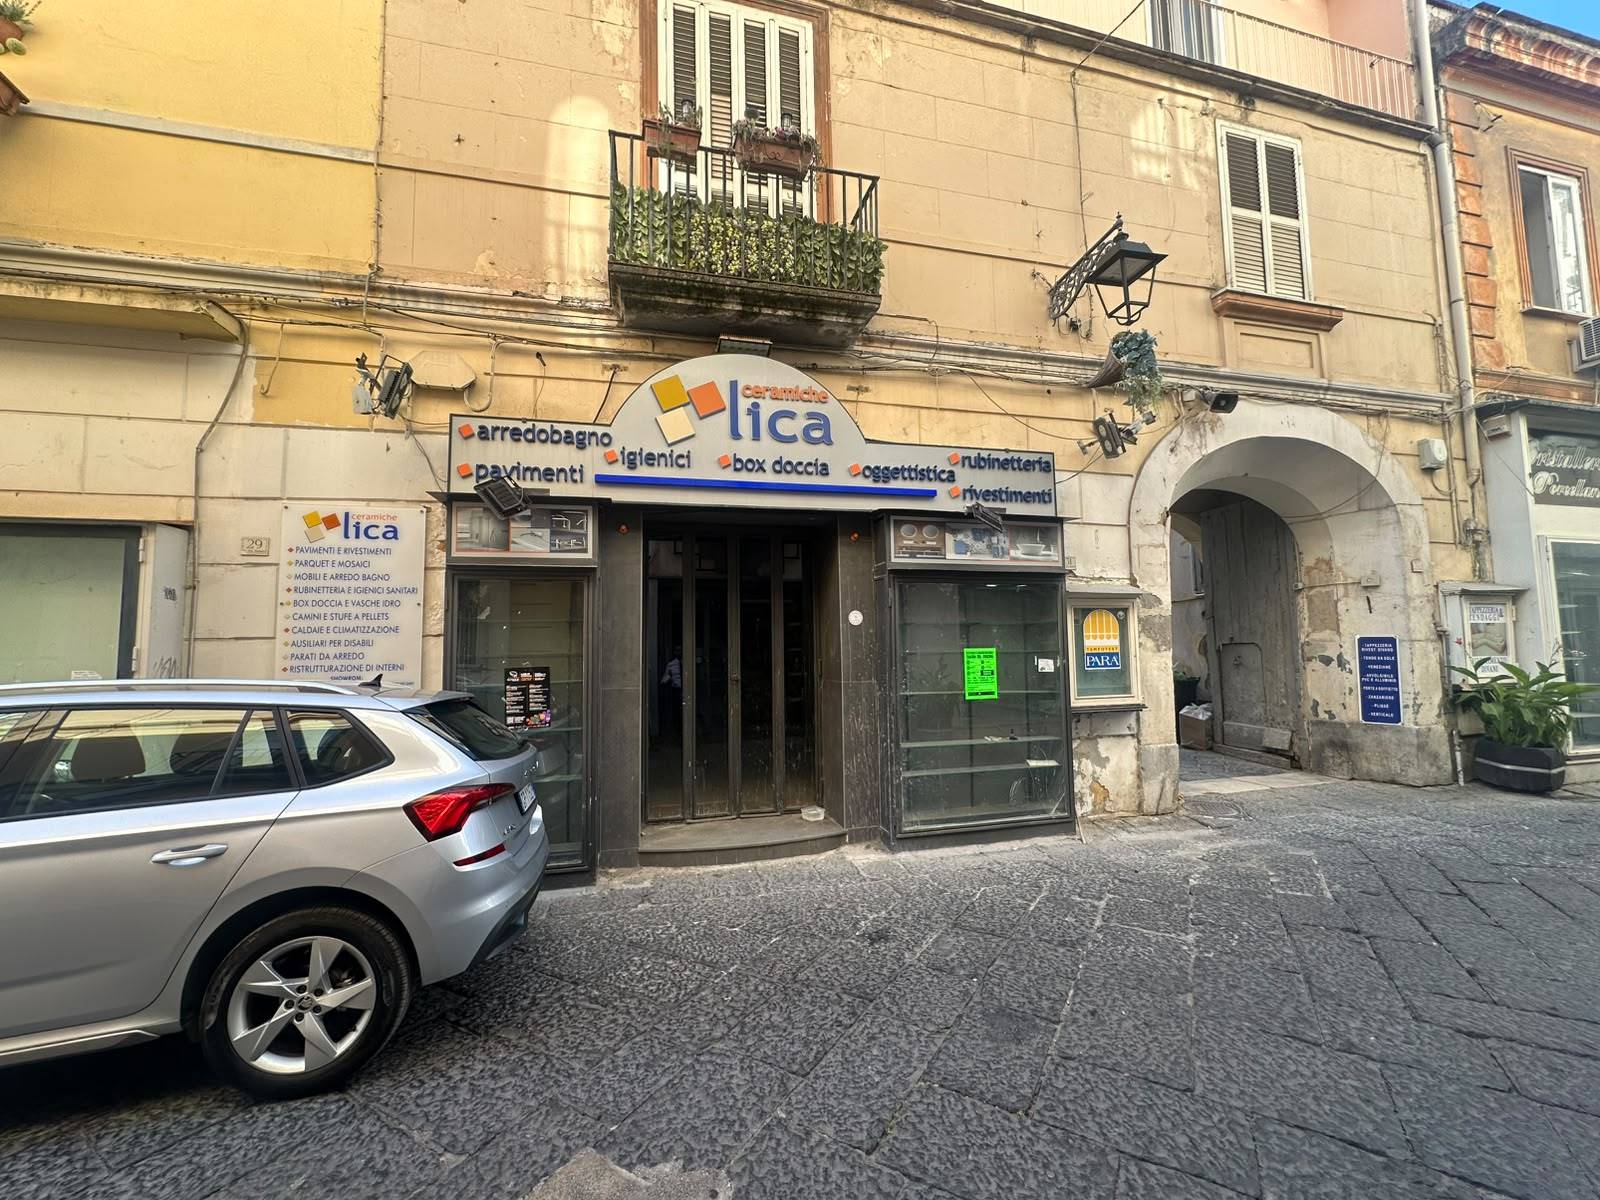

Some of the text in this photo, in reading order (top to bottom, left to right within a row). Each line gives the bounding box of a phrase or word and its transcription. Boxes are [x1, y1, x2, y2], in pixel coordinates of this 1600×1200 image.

[741, 383, 829, 403] ceramiche
[729, 379, 834, 445] lica
[477, 423, 612, 449] arredobagno
[620, 446, 691, 470] igienici
[961, 453, 1052, 473] rubinetteria
[733, 453, 830, 476] box doccia
[475, 461, 584, 484] pavimenti
[862, 464, 956, 483] oggettistica
[962, 485, 1053, 504] rivestimenti
[352, 513, 398, 521] ceramiche
[343, 511, 399, 541] lica
[246, 538, 263, 549] 29
[295, 547, 392, 555] PAVIMENTI E RIVESTIMENTI
[295, 560, 371, 568] PARQUET E MOSAICI
[294, 573, 391, 581] MOBILI E ARREDO BAGNO
[293, 586, 418, 594] RUBINETTERIA E IGIENICI SANITARI
[293, 600, 401, 608] BOX DOCCIA E VASCHE IDRO
[291, 626, 400, 634] CALDAIE E CLIMATIZZAZIONE
[290, 639, 374, 647] AUSILIARI PER DISABILI
[290, 652, 365, 660] PARATI DA ARREDO
[289, 664, 404, 673] RISTRUTTURAZIONE DI INTERNI
